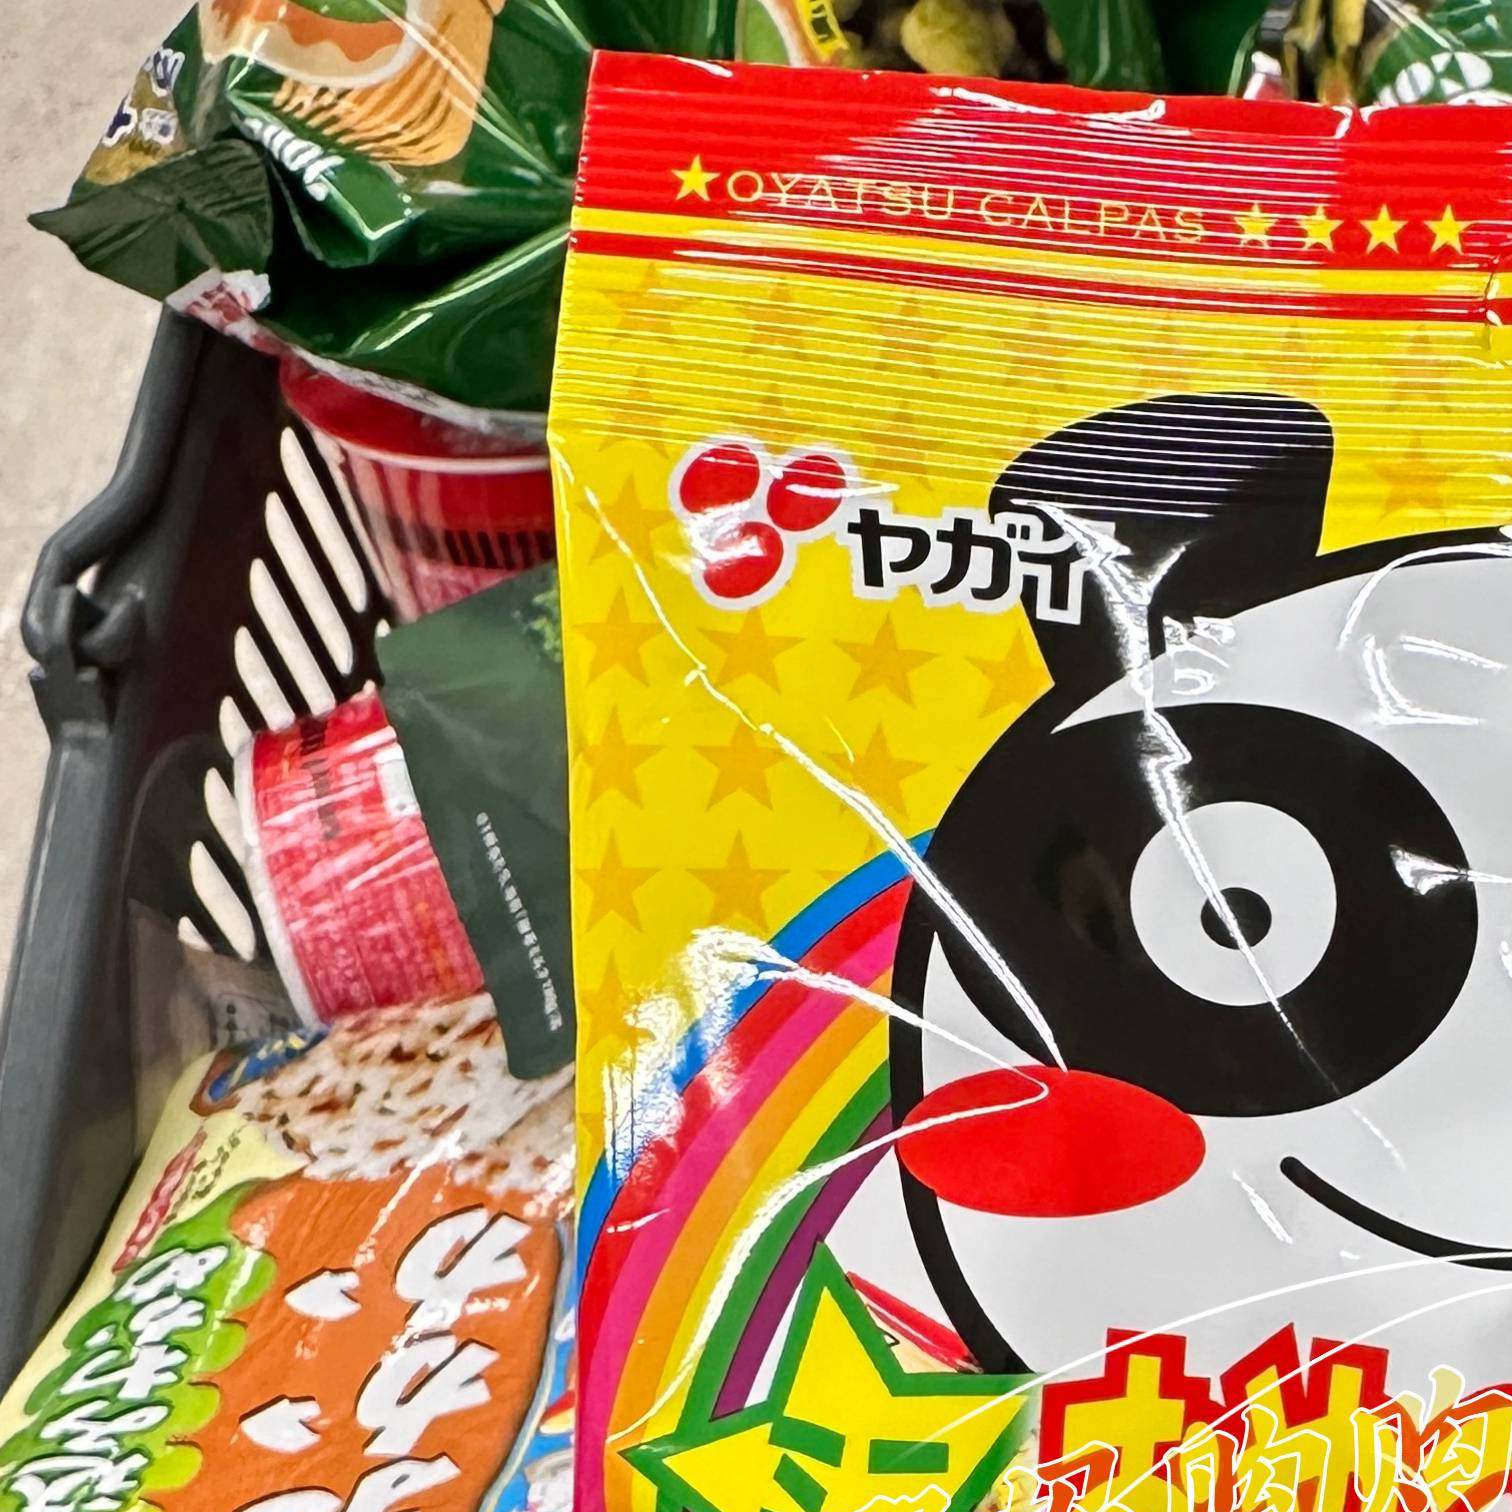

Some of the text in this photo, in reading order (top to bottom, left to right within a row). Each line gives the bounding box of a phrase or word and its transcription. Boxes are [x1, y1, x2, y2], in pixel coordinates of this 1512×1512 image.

[727, 169, 1206, 246] OYATSU CALPAS
[846, 505, 1087, 614] ヤガイ
